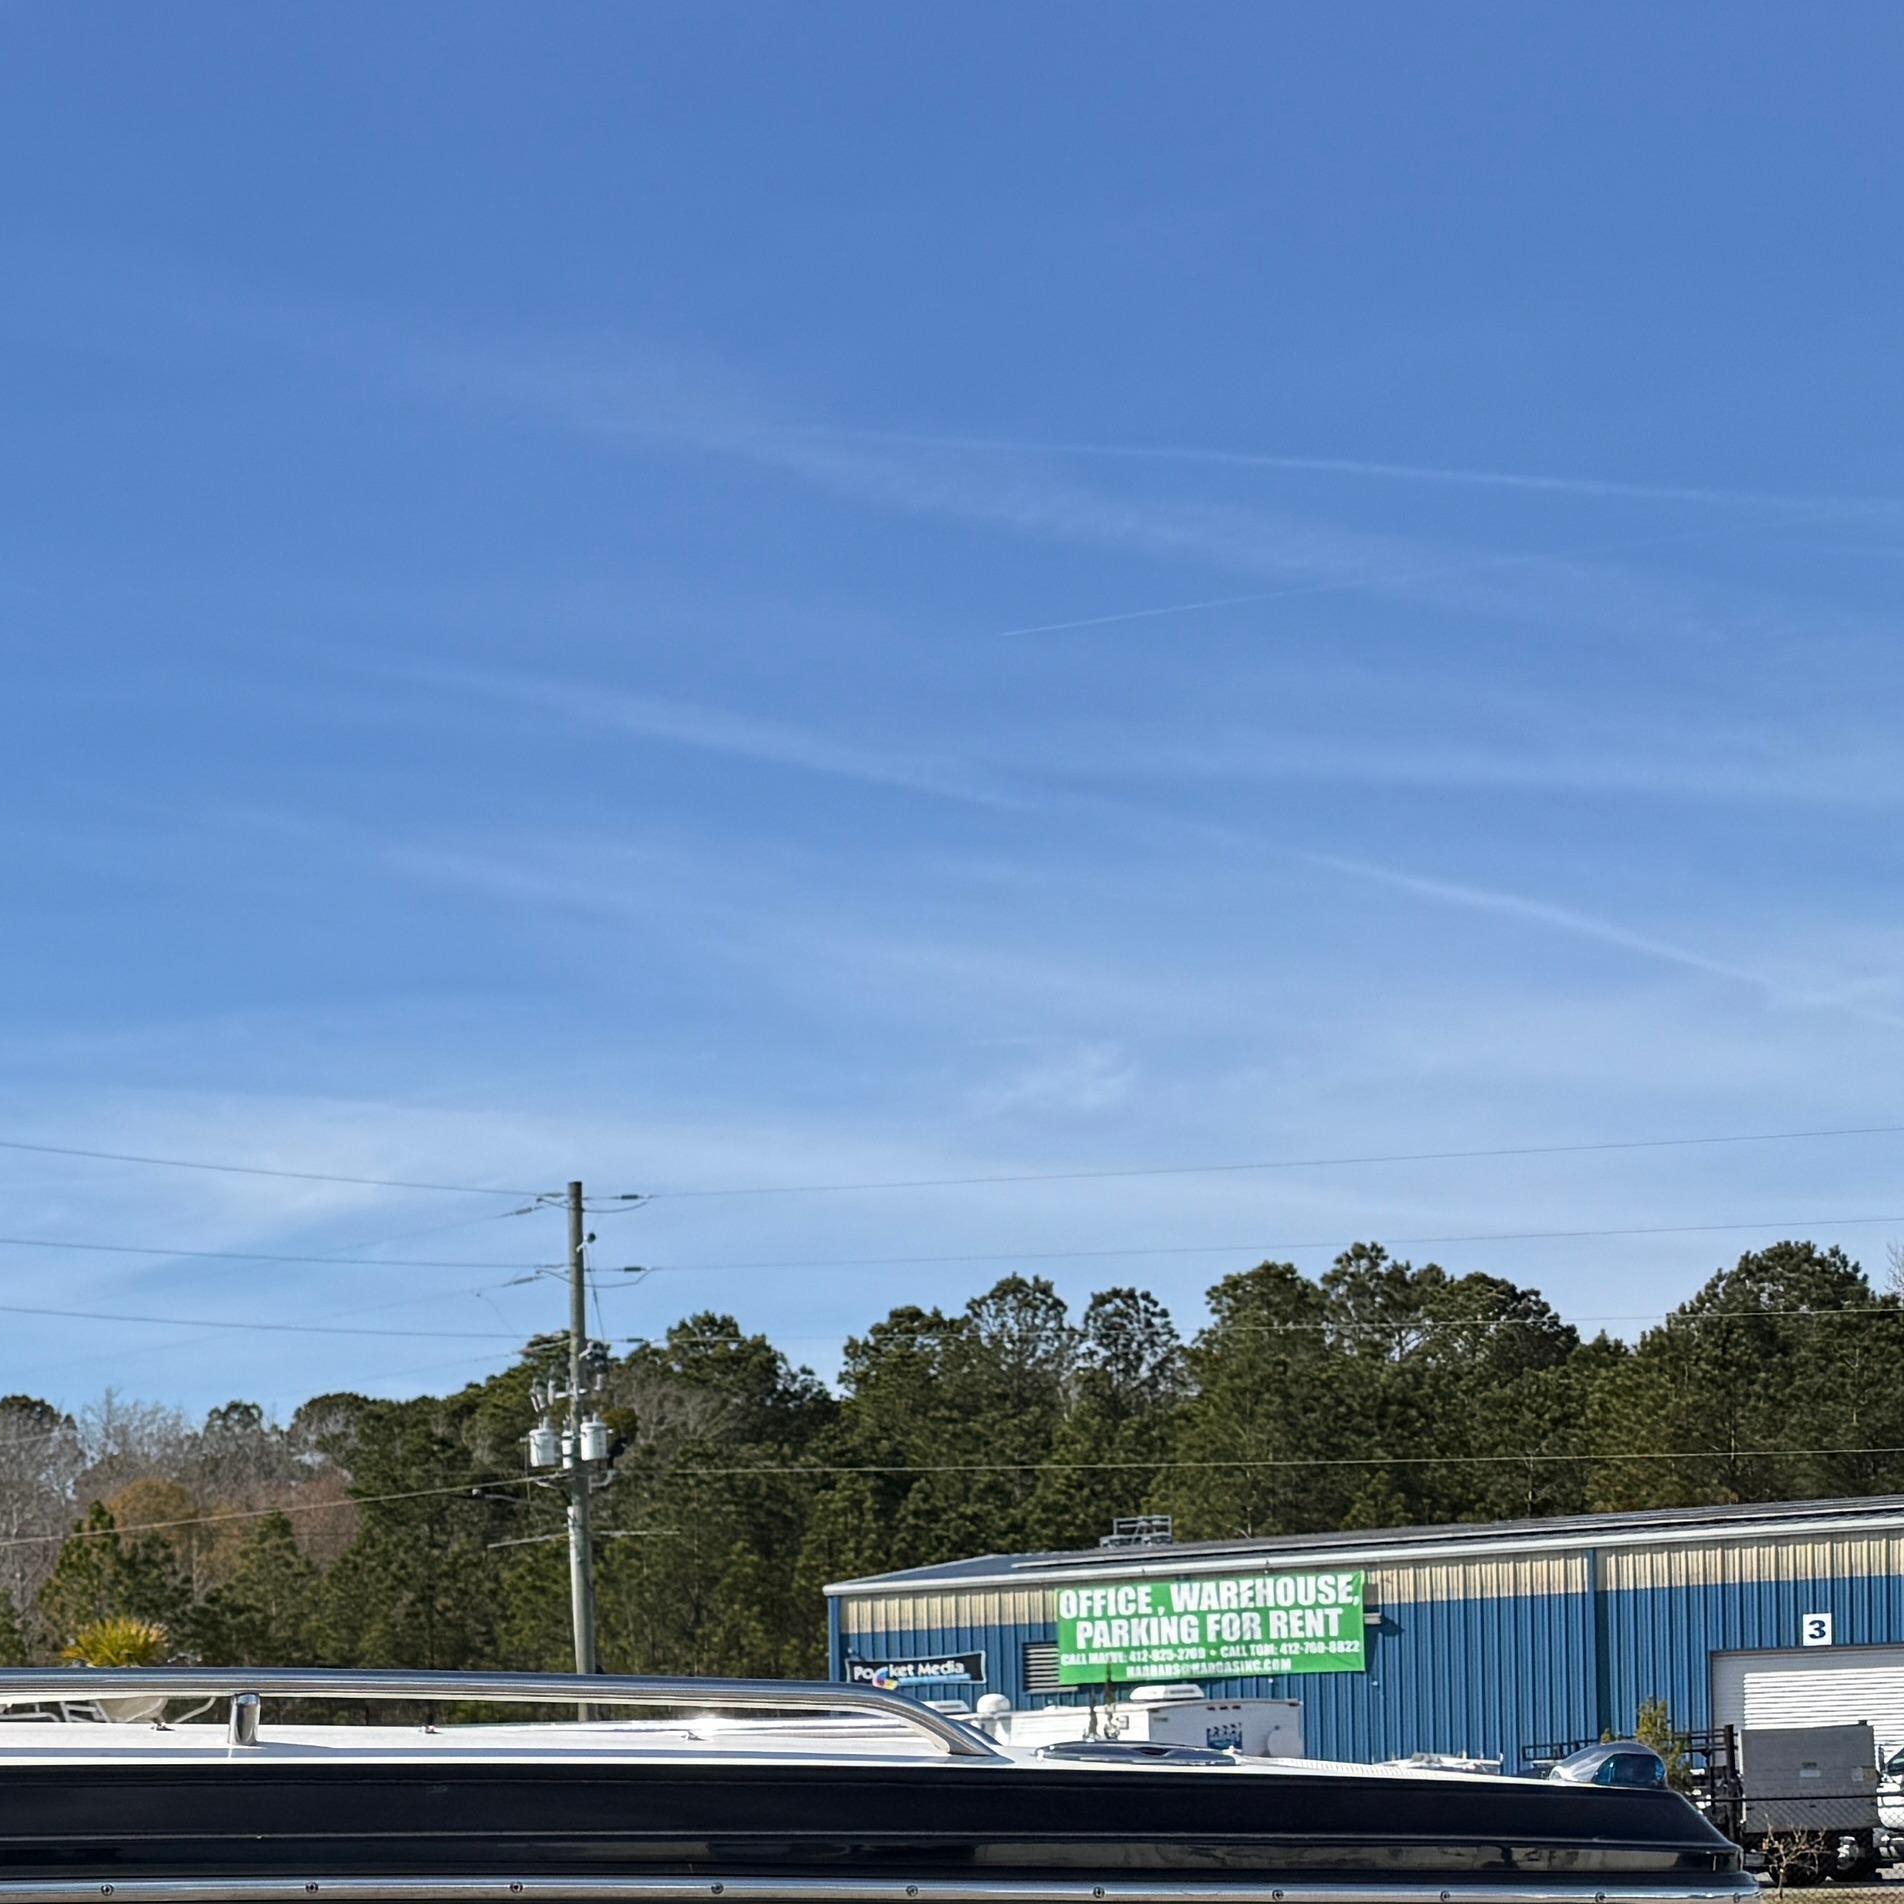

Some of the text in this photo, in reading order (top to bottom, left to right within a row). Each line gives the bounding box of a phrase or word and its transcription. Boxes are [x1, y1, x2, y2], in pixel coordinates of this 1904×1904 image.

[1171, 1574, 1360, 1613] WAREHOUSE,
[1076, 1604, 1344, 1649] PARKING FOR RENT
[1808, 1619, 1827, 1640] 3
[1060, 1652, 1087, 1666] CALL
[1220, 1645, 1248, 1658] CALL
[917, 1660, 965, 1676] Media
